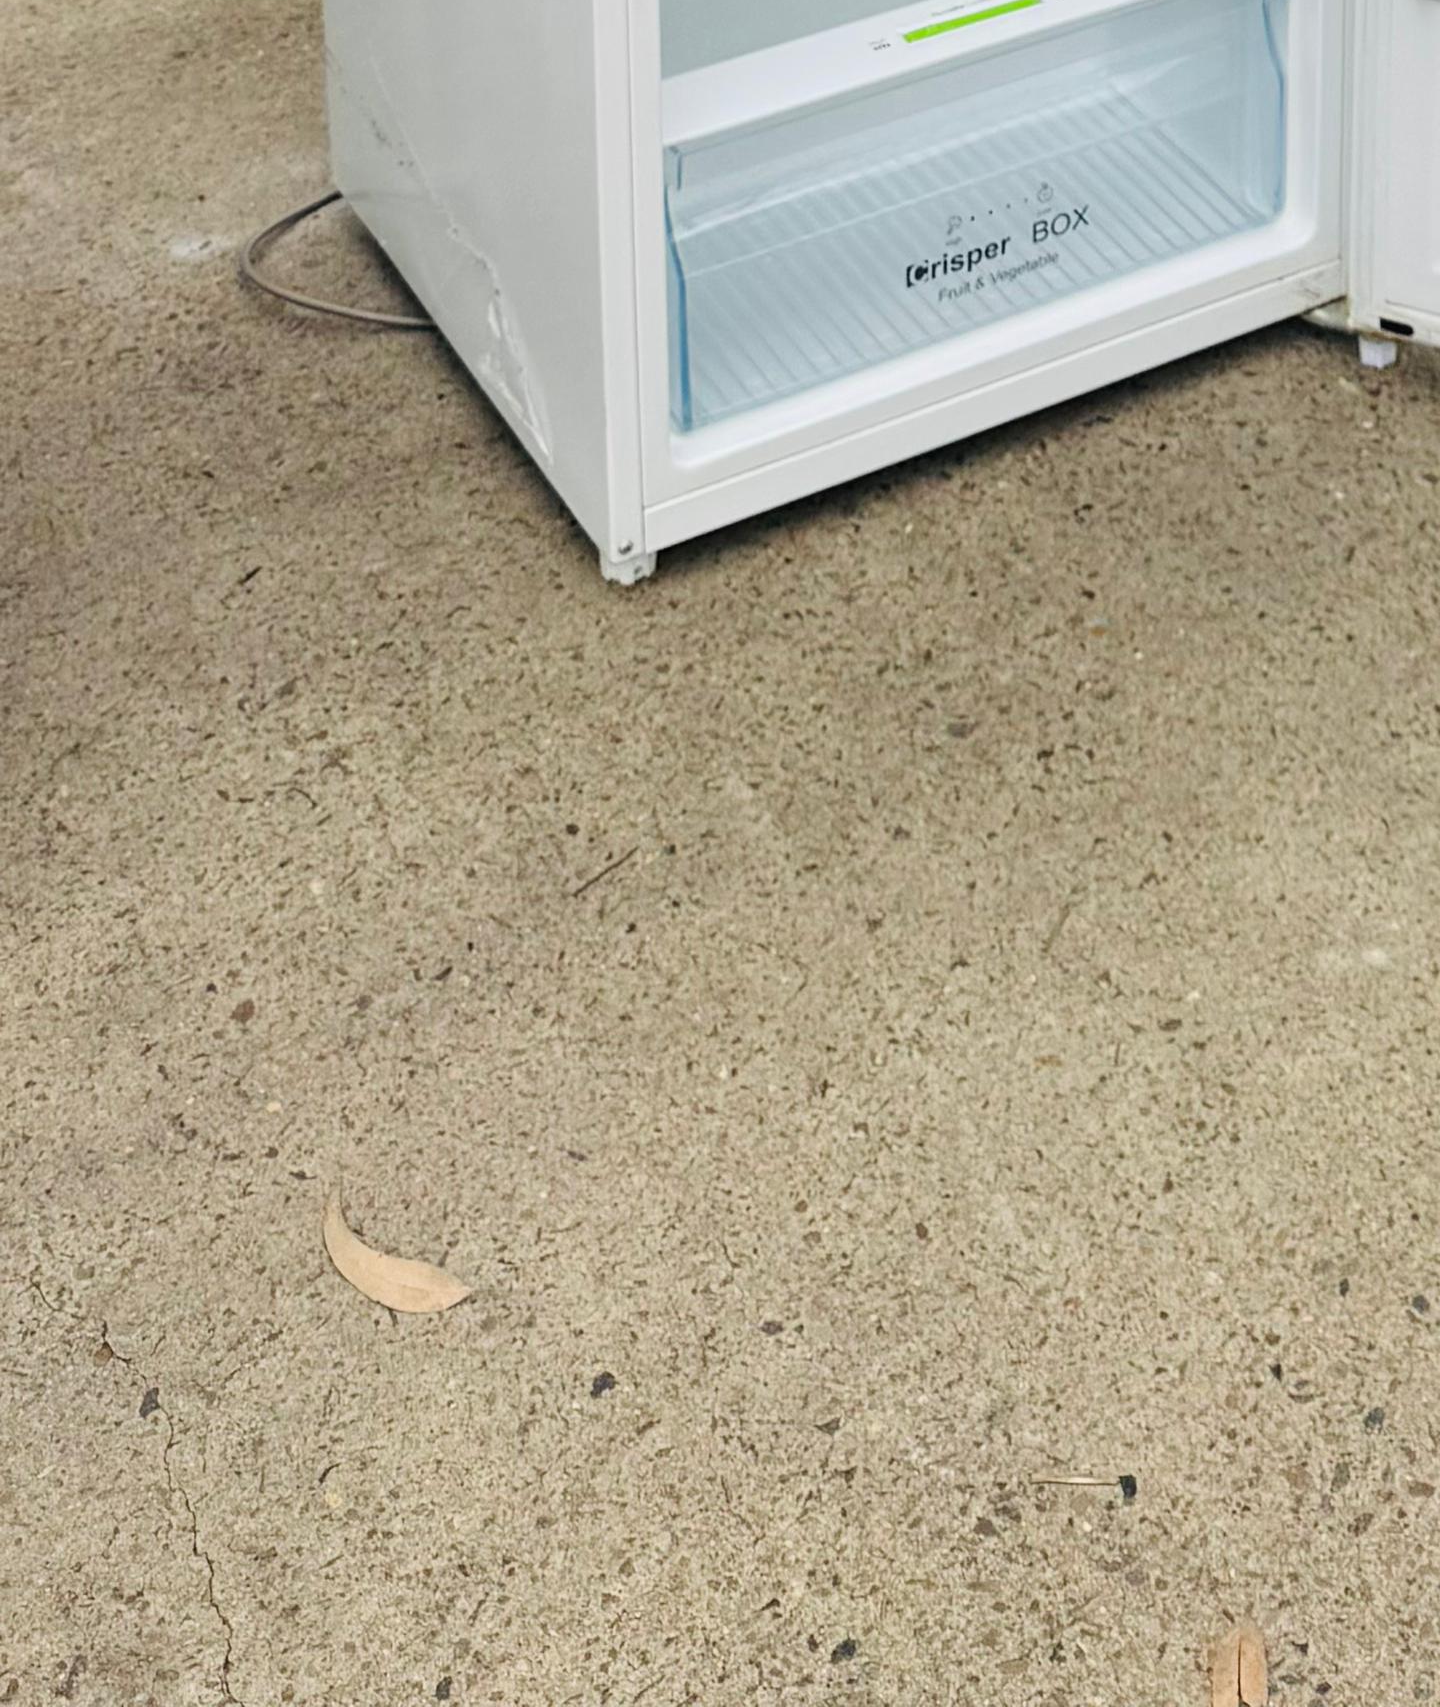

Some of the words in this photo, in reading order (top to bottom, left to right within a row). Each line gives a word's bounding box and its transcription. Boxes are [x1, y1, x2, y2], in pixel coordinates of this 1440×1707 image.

[905, 236, 1011, 288] Crisper
[1032, 204, 1090, 243] BOX
[937, 277, 972, 302] Fruit
[990, 251, 1060, 288] Vegetable
